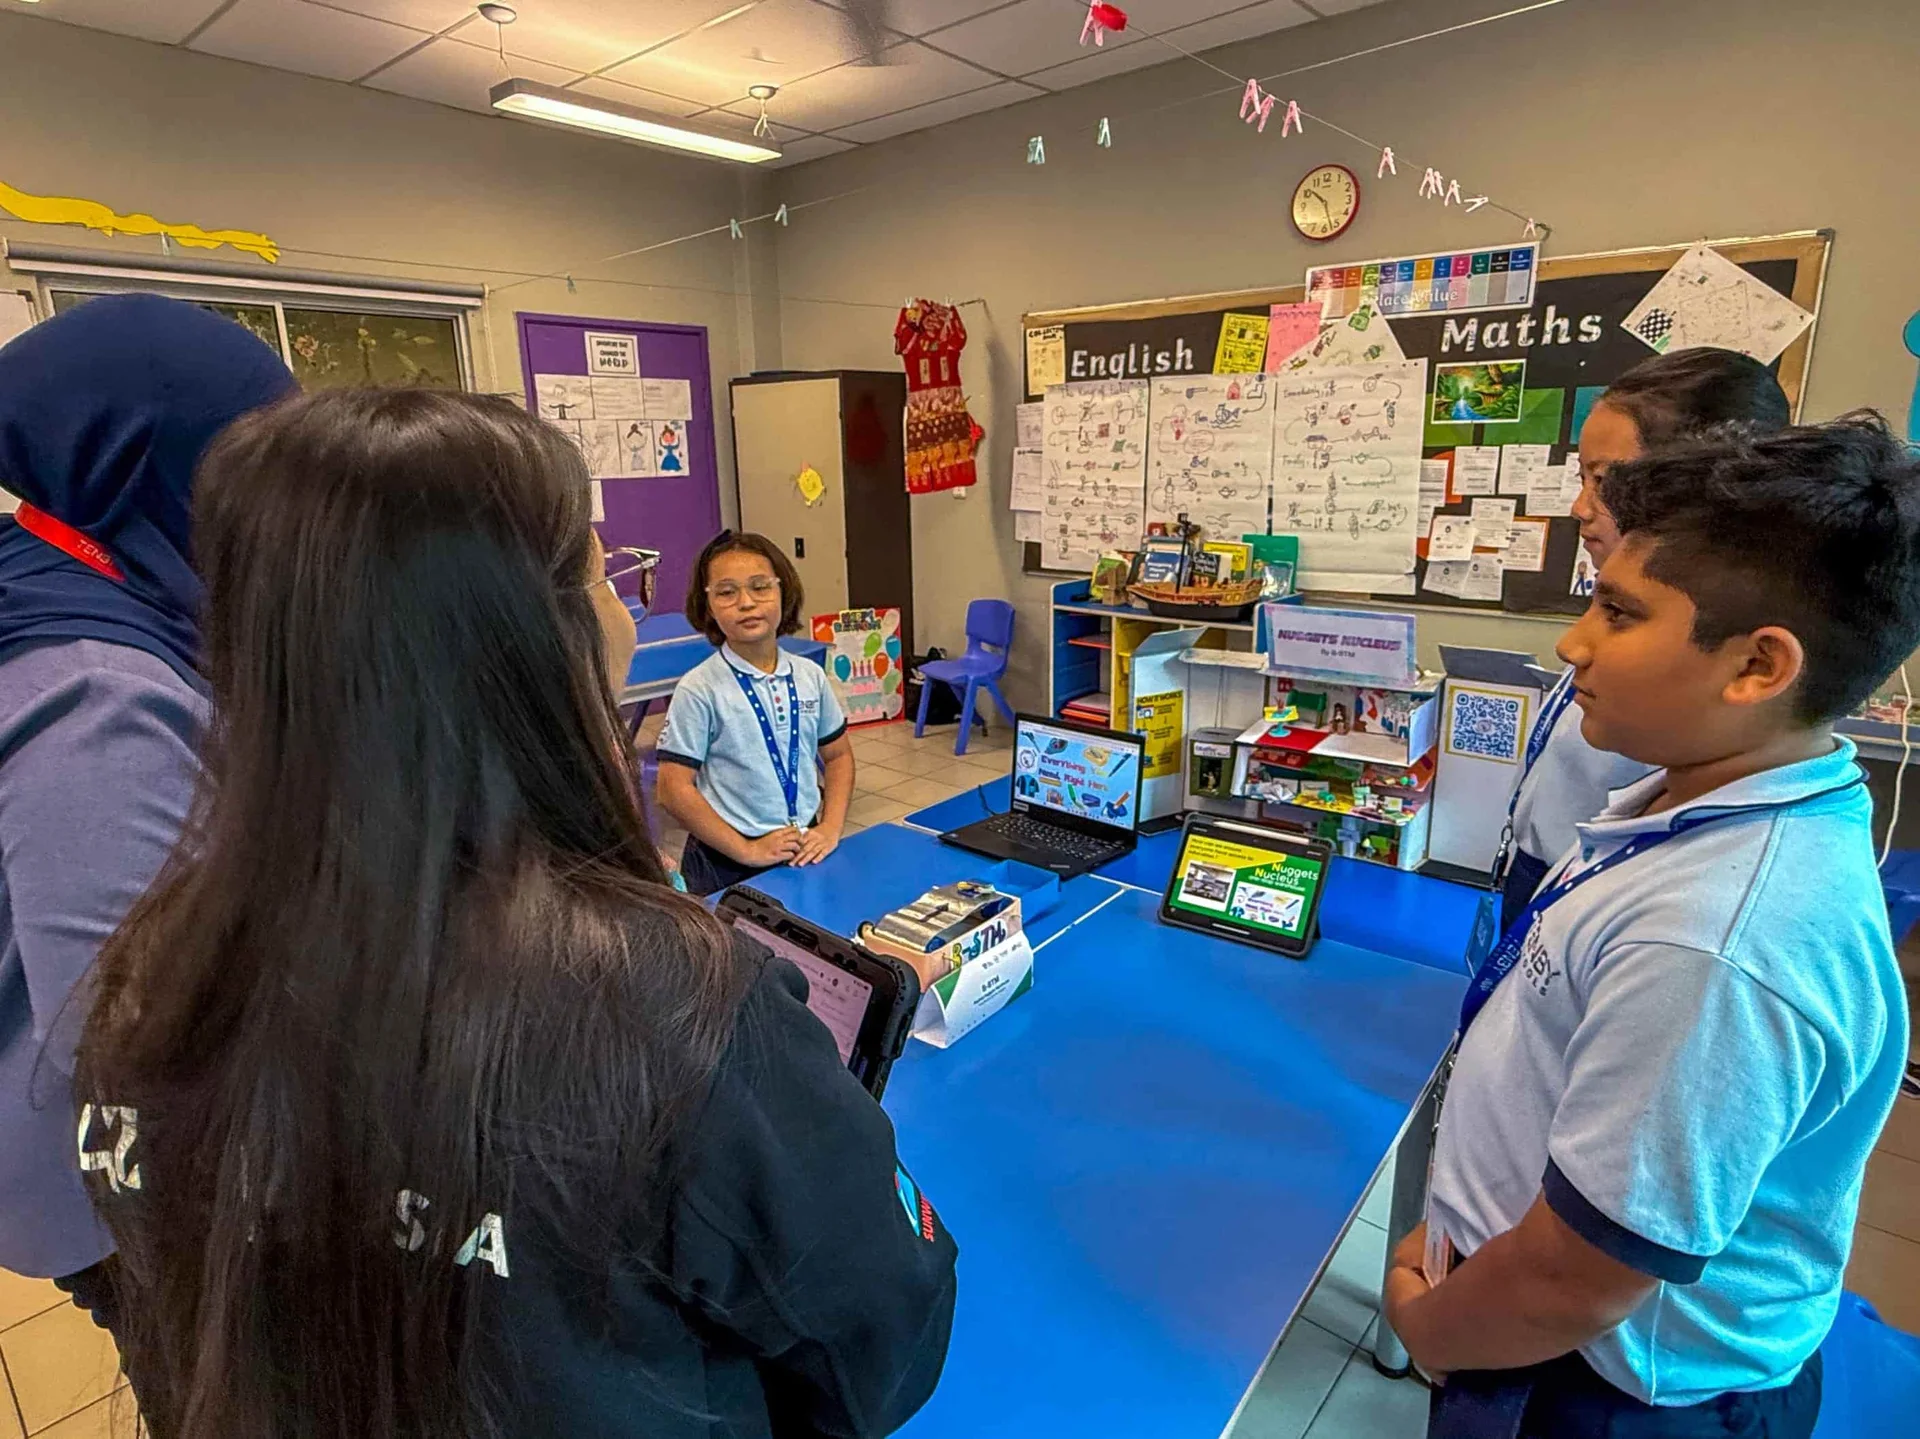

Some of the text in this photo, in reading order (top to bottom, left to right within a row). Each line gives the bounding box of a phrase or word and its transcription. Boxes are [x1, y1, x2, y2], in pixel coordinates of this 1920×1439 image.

[1313, 177, 1320, 188] 11
[1323, 172, 1331, 182] 12
[1345, 182, 1351, 192] 2
[1345, 194, 1351, 204] 3
[1441, 305, 1602, 353] Maths
[1071, 338, 1194, 380] English
[1041, 755, 1086, 774] Everything
[1255, 868, 1300, 886] Nucleus
[1272, 863, 1319, 881] Nuggets
